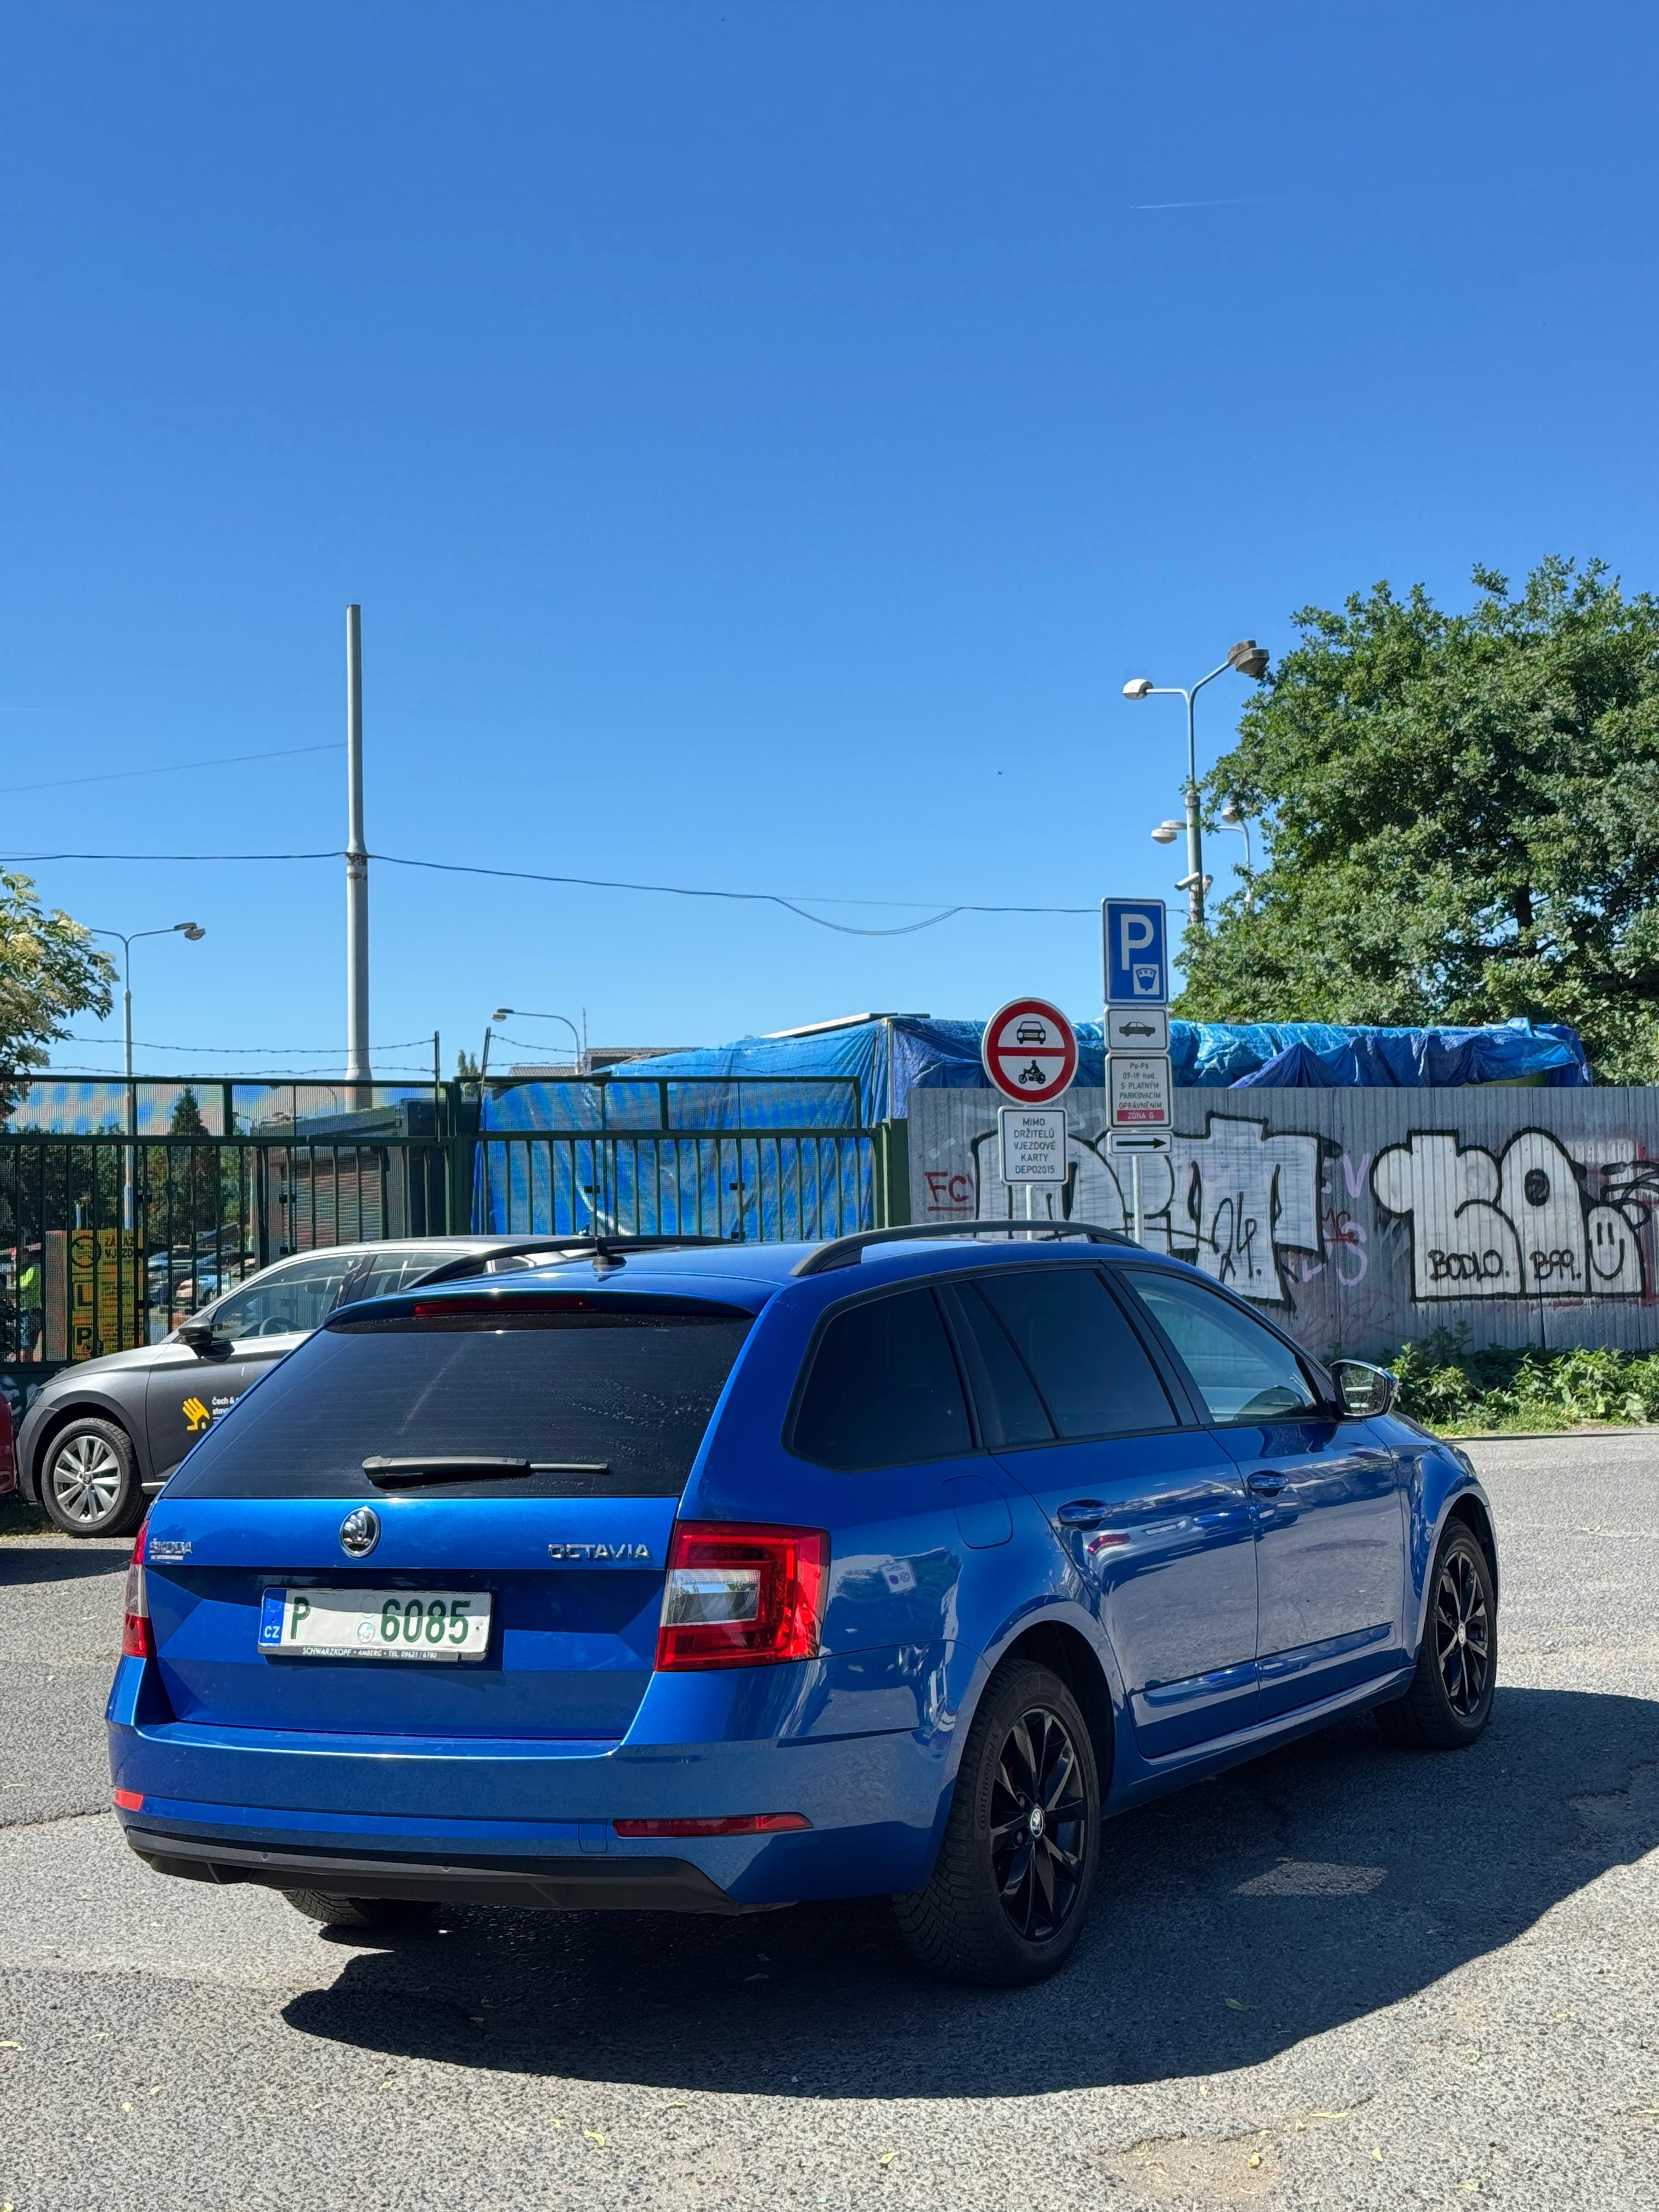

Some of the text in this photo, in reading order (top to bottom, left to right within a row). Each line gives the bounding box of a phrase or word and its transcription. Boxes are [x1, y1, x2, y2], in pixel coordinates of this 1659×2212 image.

[1120, 913, 1154, 970] P
[1128, 1081, 1159, 1089] PLATNÝM
[1119, 1091, 1161, 1099] PARKOVACÍM
[1119, 1101, 1163, 1109] OPRÁVNĚNÍM
[1128, 1111, 1146, 1120] ZÓNA
[1023, 1118, 1045, 1126] MIMO
[1014, 1127, 1054, 1138] DRŽITELŮ
[1013, 1140, 1056, 1150] VJEZDOVÉ
[1020, 1153, 1048, 1162] KARTY
[1015, 1165, 1055, 1174] DEPO2015
[148, 1538, 193, 1554] ŠKODA
[548, 1543, 651, 1559] OCTAVIA
[290, 1596, 471, 1644] P 6085
[264, 1625, 280, 1639] CZ
[302, 1647, 352, 1656] SCHWARZKOPF
[978, 1740, 997, 1830] Continental
